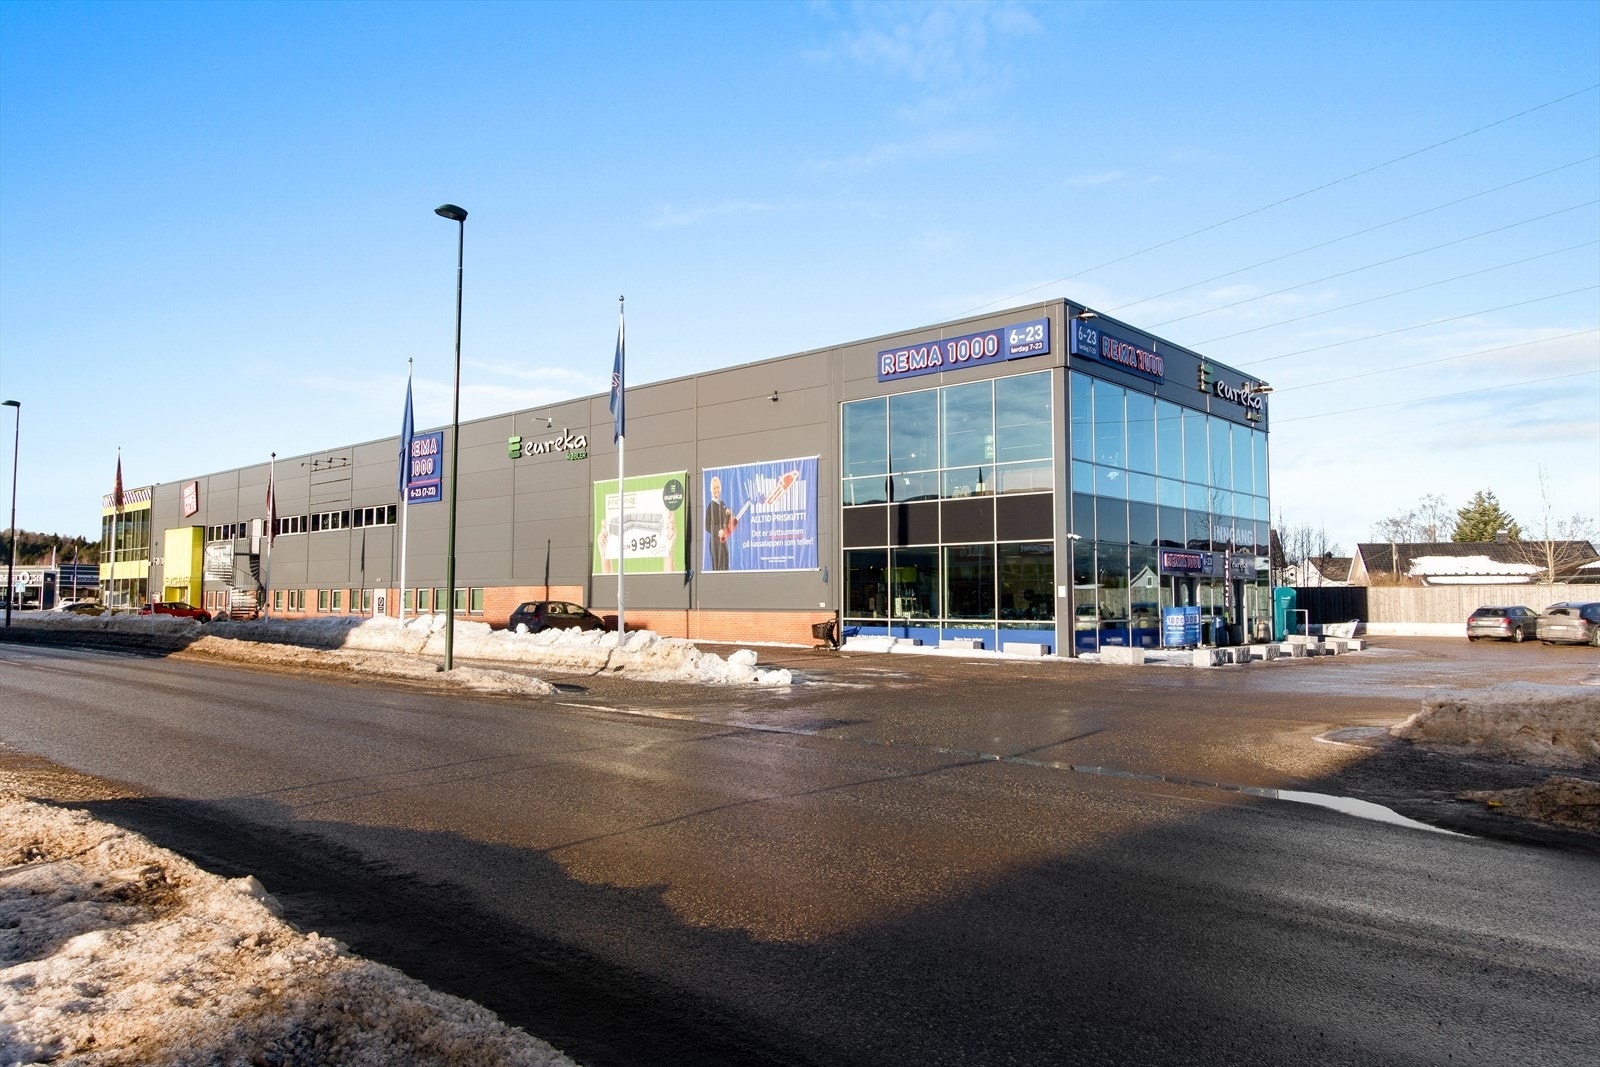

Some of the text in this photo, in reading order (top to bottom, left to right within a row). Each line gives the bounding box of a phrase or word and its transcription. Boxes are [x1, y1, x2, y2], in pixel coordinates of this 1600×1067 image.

[1009, 325, 1044, 344] 6-23
[1078, 326, 1097, 345] 6-23
[882, 334, 998, 375] REMA 1000
[1029, 342, 1043, 350] 7-23
[1101, 336, 1164, 377] REMA 1000
[1217, 380, 1263, 410] eureka
[411, 438, 438, 457] EMA
[525, 428, 587, 457] eureka
[750, 513, 806, 524] ALLTID PRISKUTT!
[769, 529, 804, 537] sluttsummen
[1213, 525, 1253, 544] INNGANG
[743, 540, 750, 549] på
[750, 540, 784, 549] kassalappen
[797, 537, 814, 546] teller!
